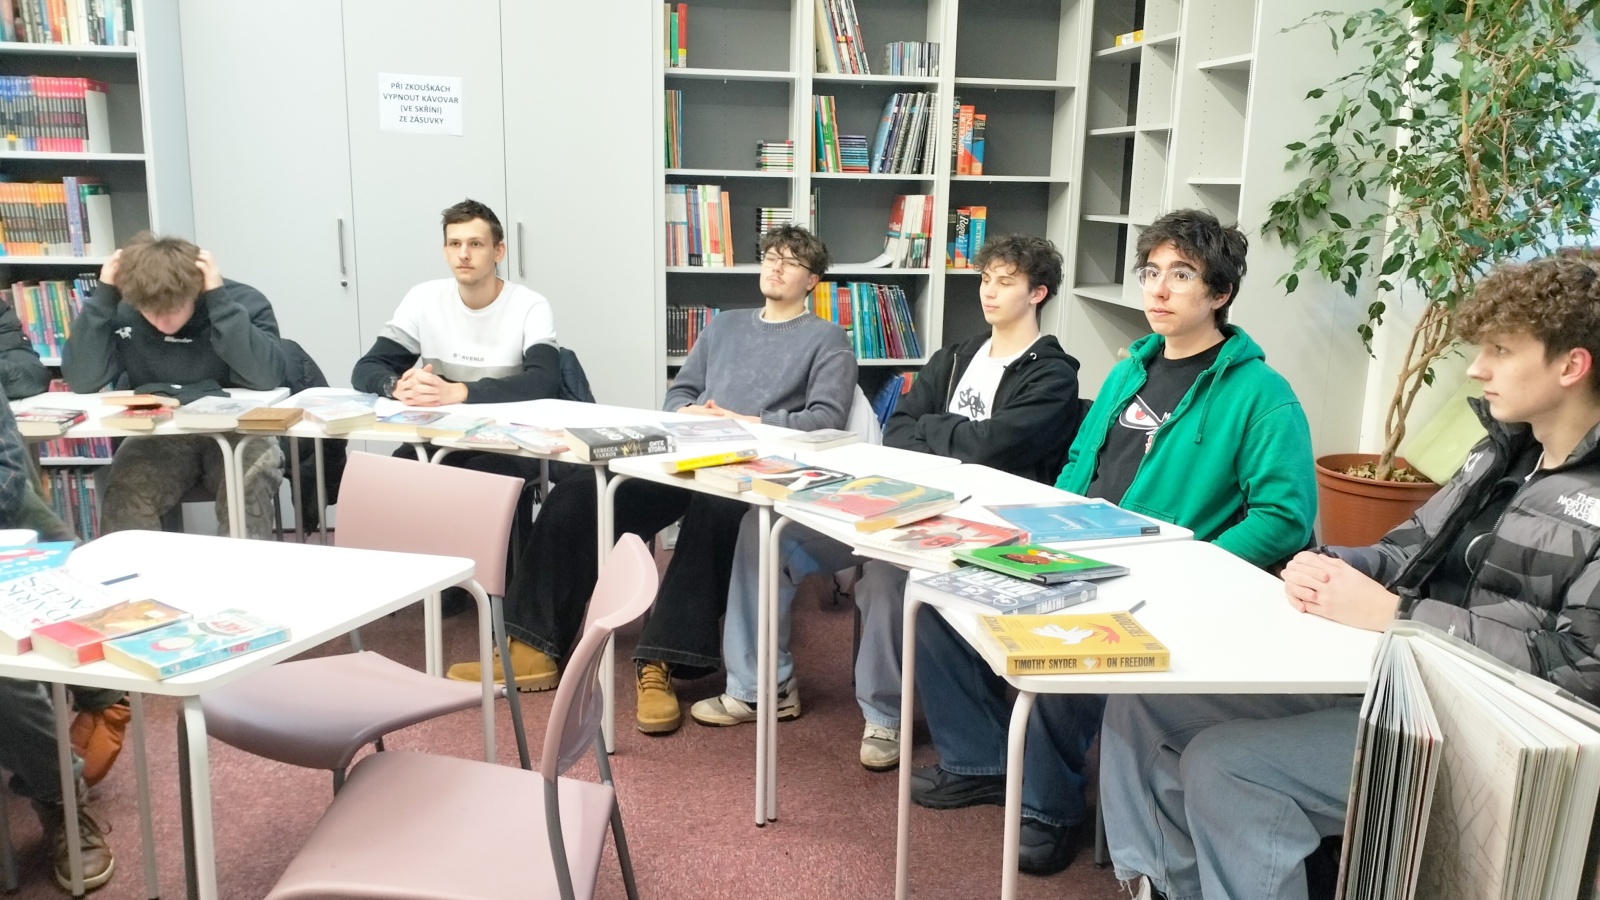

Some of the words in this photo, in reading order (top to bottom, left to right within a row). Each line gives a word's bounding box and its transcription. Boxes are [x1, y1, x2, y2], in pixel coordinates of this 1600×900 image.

[391, 82, 403, 90] PŘI
[405, 83, 451, 93] ZKOUŠKÁCH
[383, 93, 419, 102] VYPNOUT
[422, 94, 459, 104] KÁVOVAR
[400, 104, 413, 113] (VE
[415, 105, 442, 115] SKŘÍNI)
[399, 115, 408, 123] ZE
[410, 115, 444, 125] ZÁSUVKY
[965, 113, 973, 144] ENGLISH
[956, 215, 969, 244] Roget's
[461, 354, 485, 362] AVENUE
[593, 446, 618, 454] REBECCA
[1557, 495, 1590, 513] NORTH
[1577, 492, 1596, 506] THE
[1564, 506, 1589, 521] FACE
[22, 577, 94, 610] AGES
[7, 584, 71, 621] DARK
[1014, 659, 1046, 670] TIMOTHY
[1050, 658, 1077, 669] SNYDER
[1107, 657, 1117, 668] ON
[1120, 656, 1155, 668] FREEDOM
